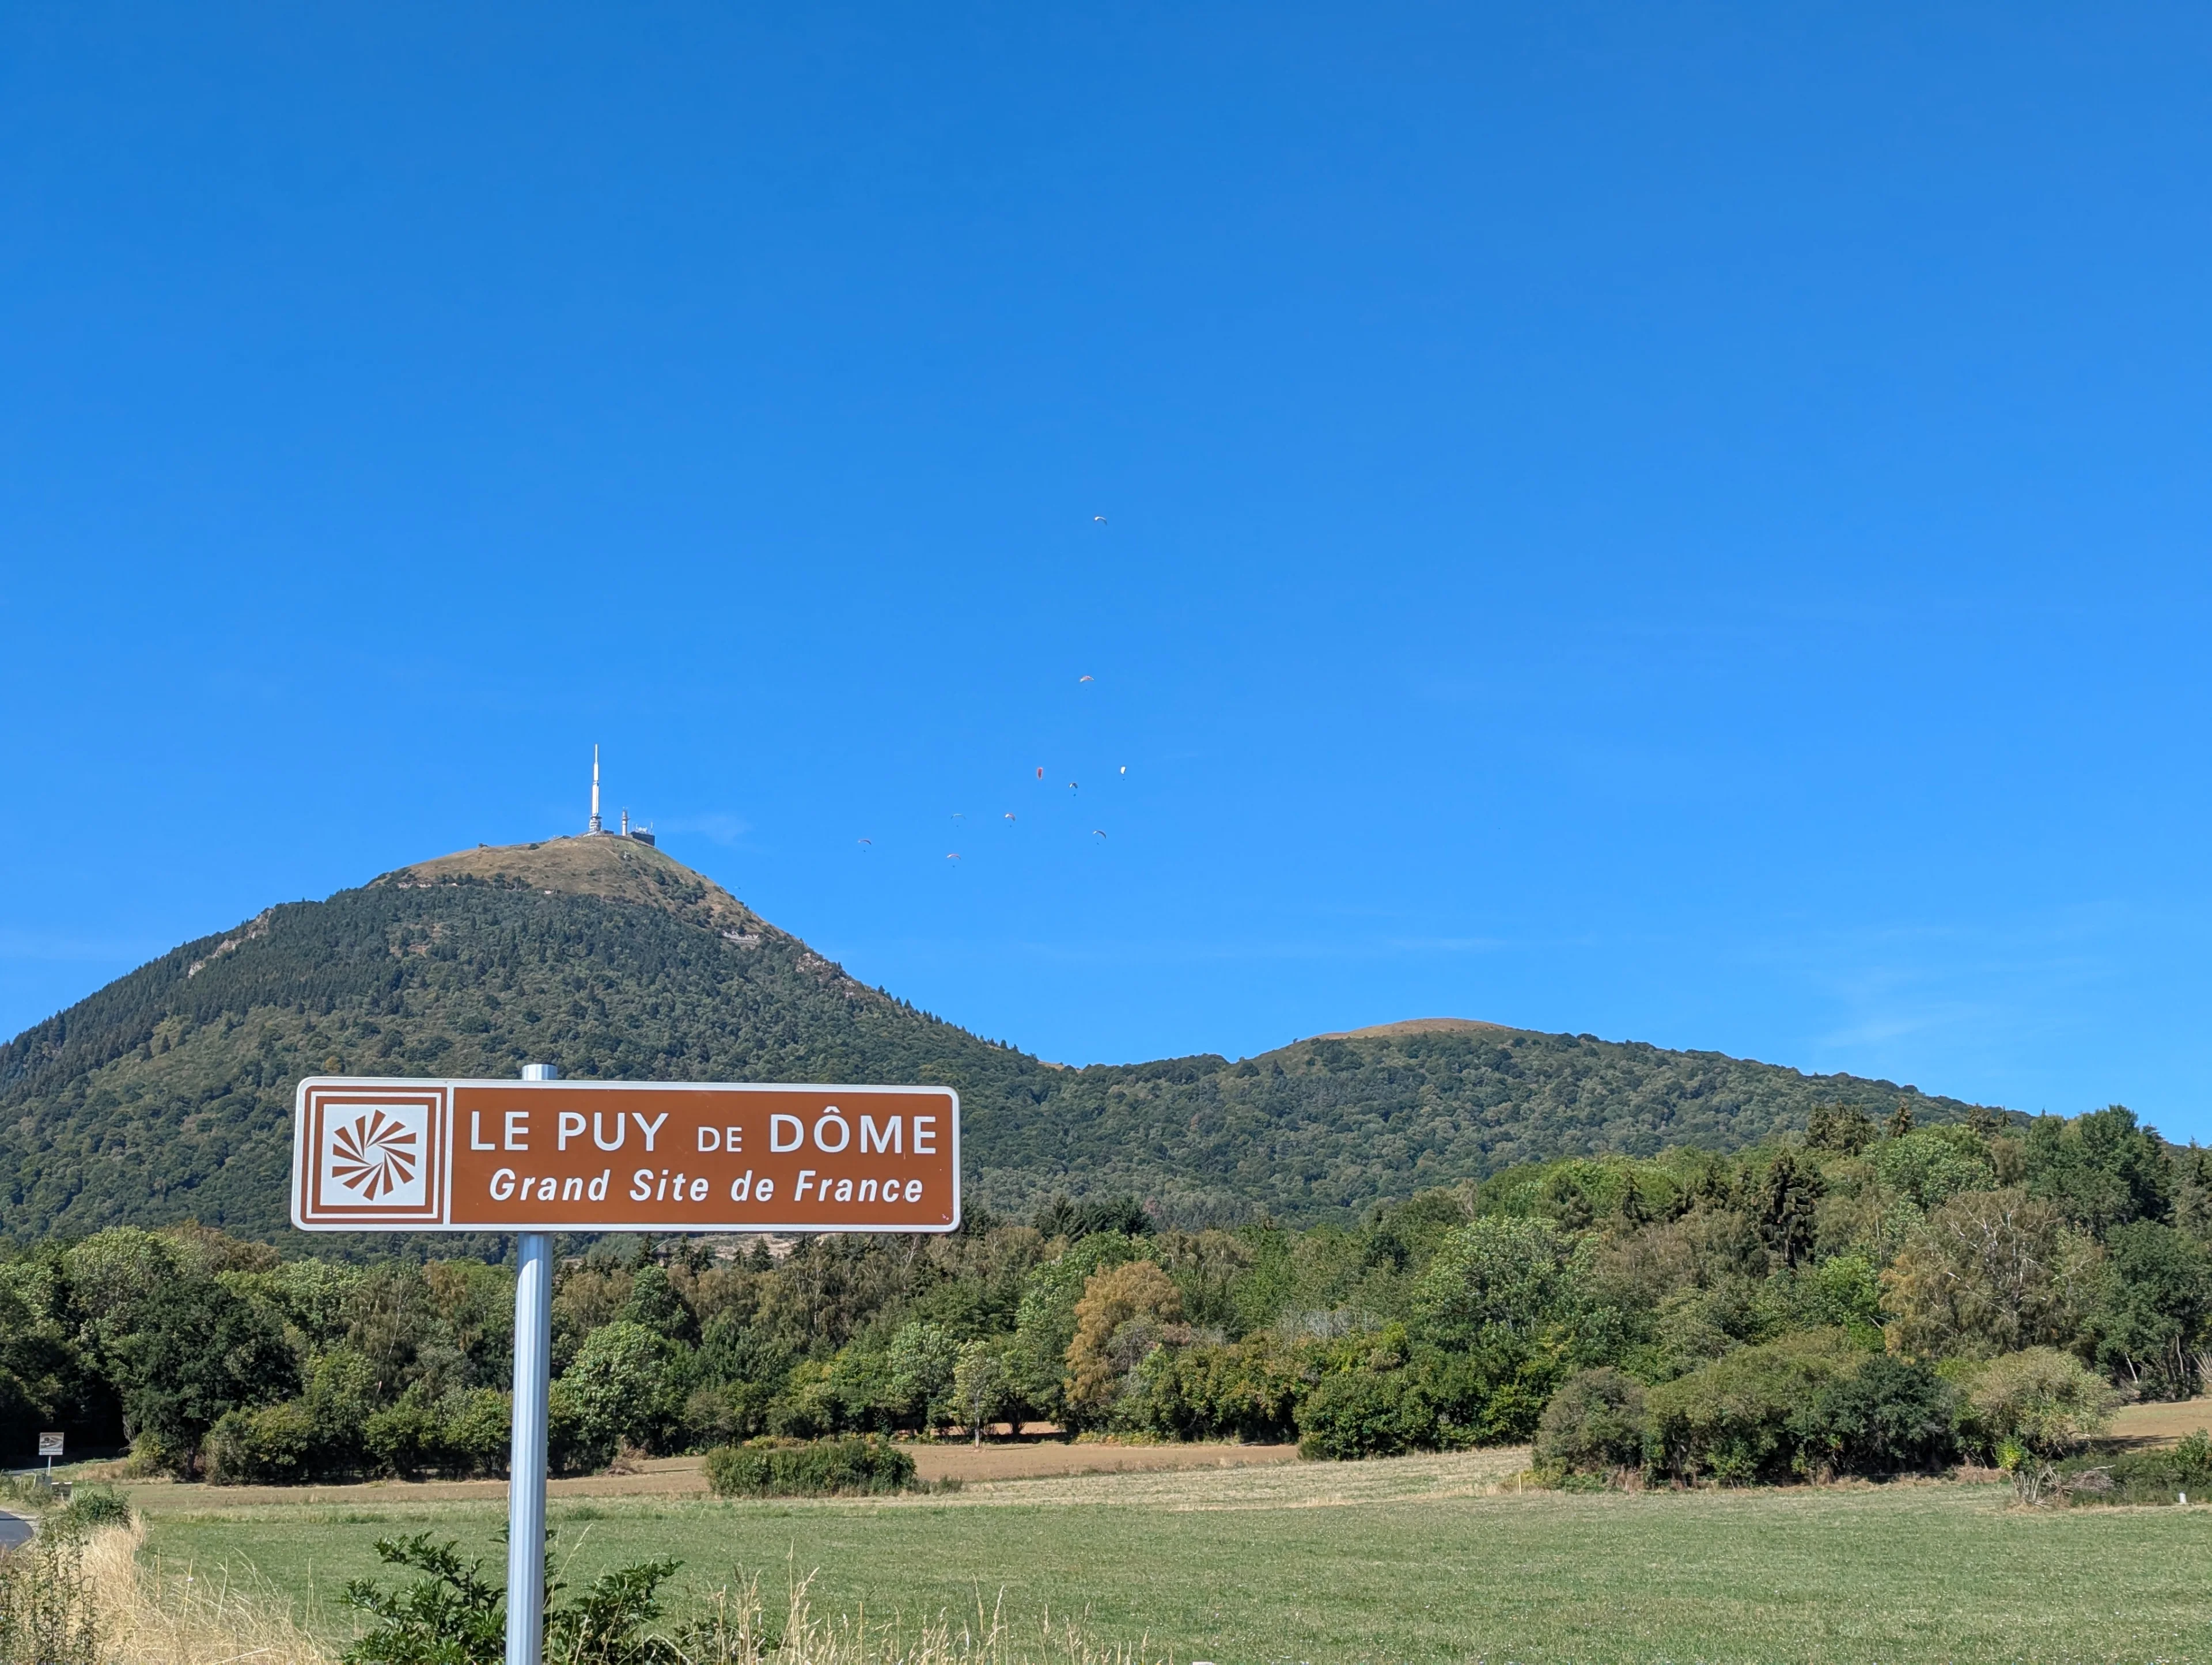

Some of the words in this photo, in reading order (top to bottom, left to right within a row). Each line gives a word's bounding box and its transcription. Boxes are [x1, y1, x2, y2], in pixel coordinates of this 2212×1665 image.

[471, 1111, 529, 1151] LE
[558, 1112, 669, 1152] PUY
[698, 1127, 743, 1152] DE
[770, 1106, 937, 1155] DÔME
[490, 1168, 611, 1201] Grand
[630, 1169, 709, 1202] Site
[730, 1170, 774, 1202] de
[794, 1170, 923, 1203] France
